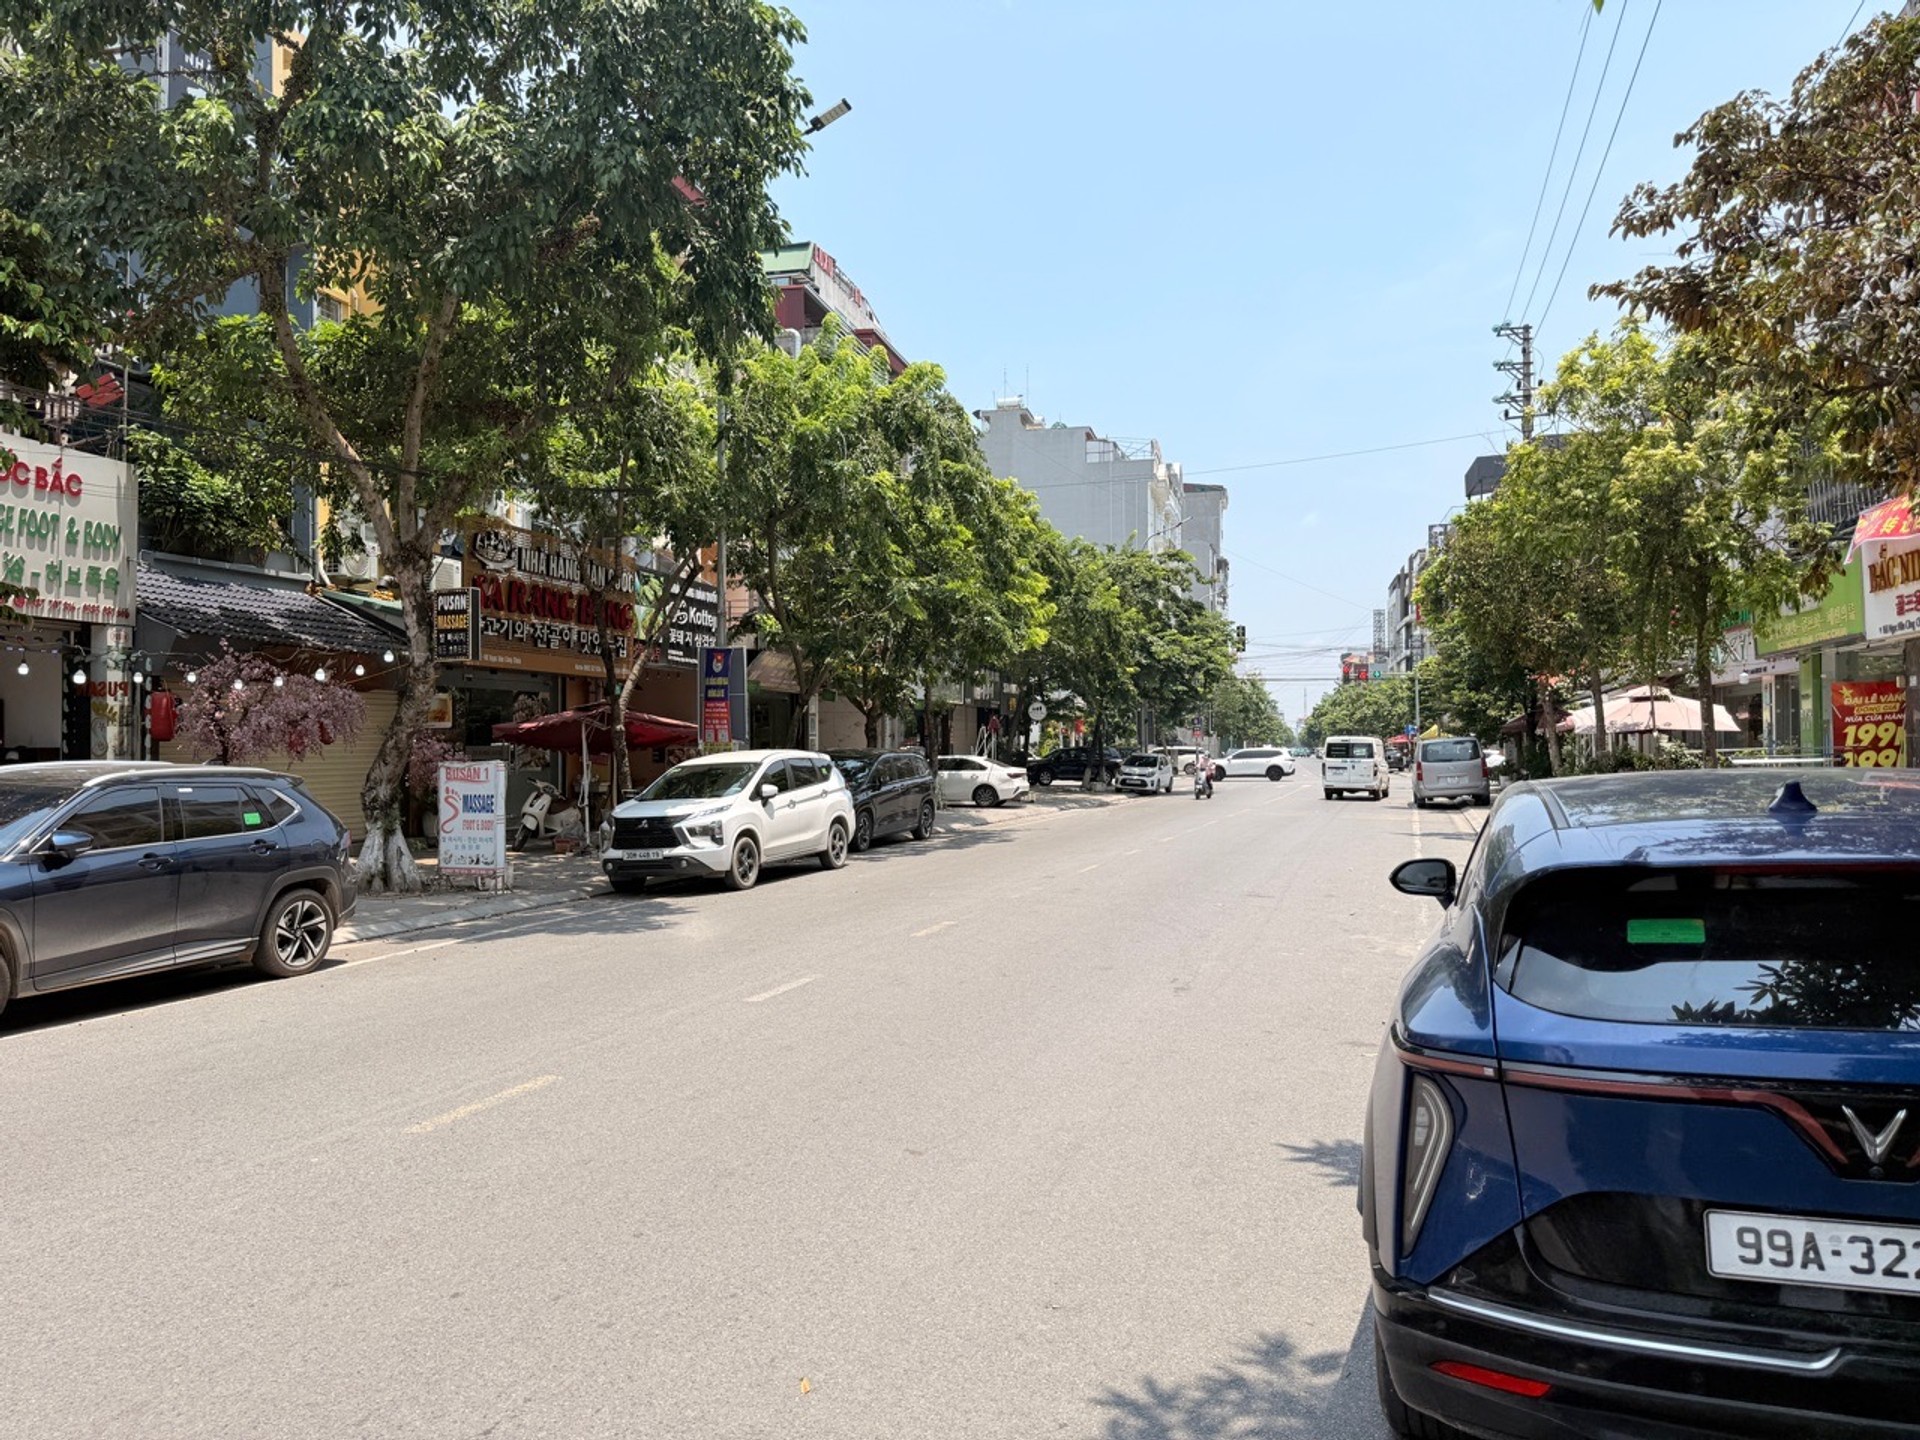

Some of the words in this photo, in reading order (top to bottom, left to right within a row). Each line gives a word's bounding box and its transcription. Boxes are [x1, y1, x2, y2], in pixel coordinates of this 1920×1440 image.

[35, 457, 82, 497] BẮC
[18, 508, 60, 540] FOOT
[66, 516, 80, 544] &
[84, 520, 121, 552] BODY
[438, 594, 467, 611] PUSAN
[578, 594, 634, 631] BNG
[462, 794, 495, 814] MASSAGE
